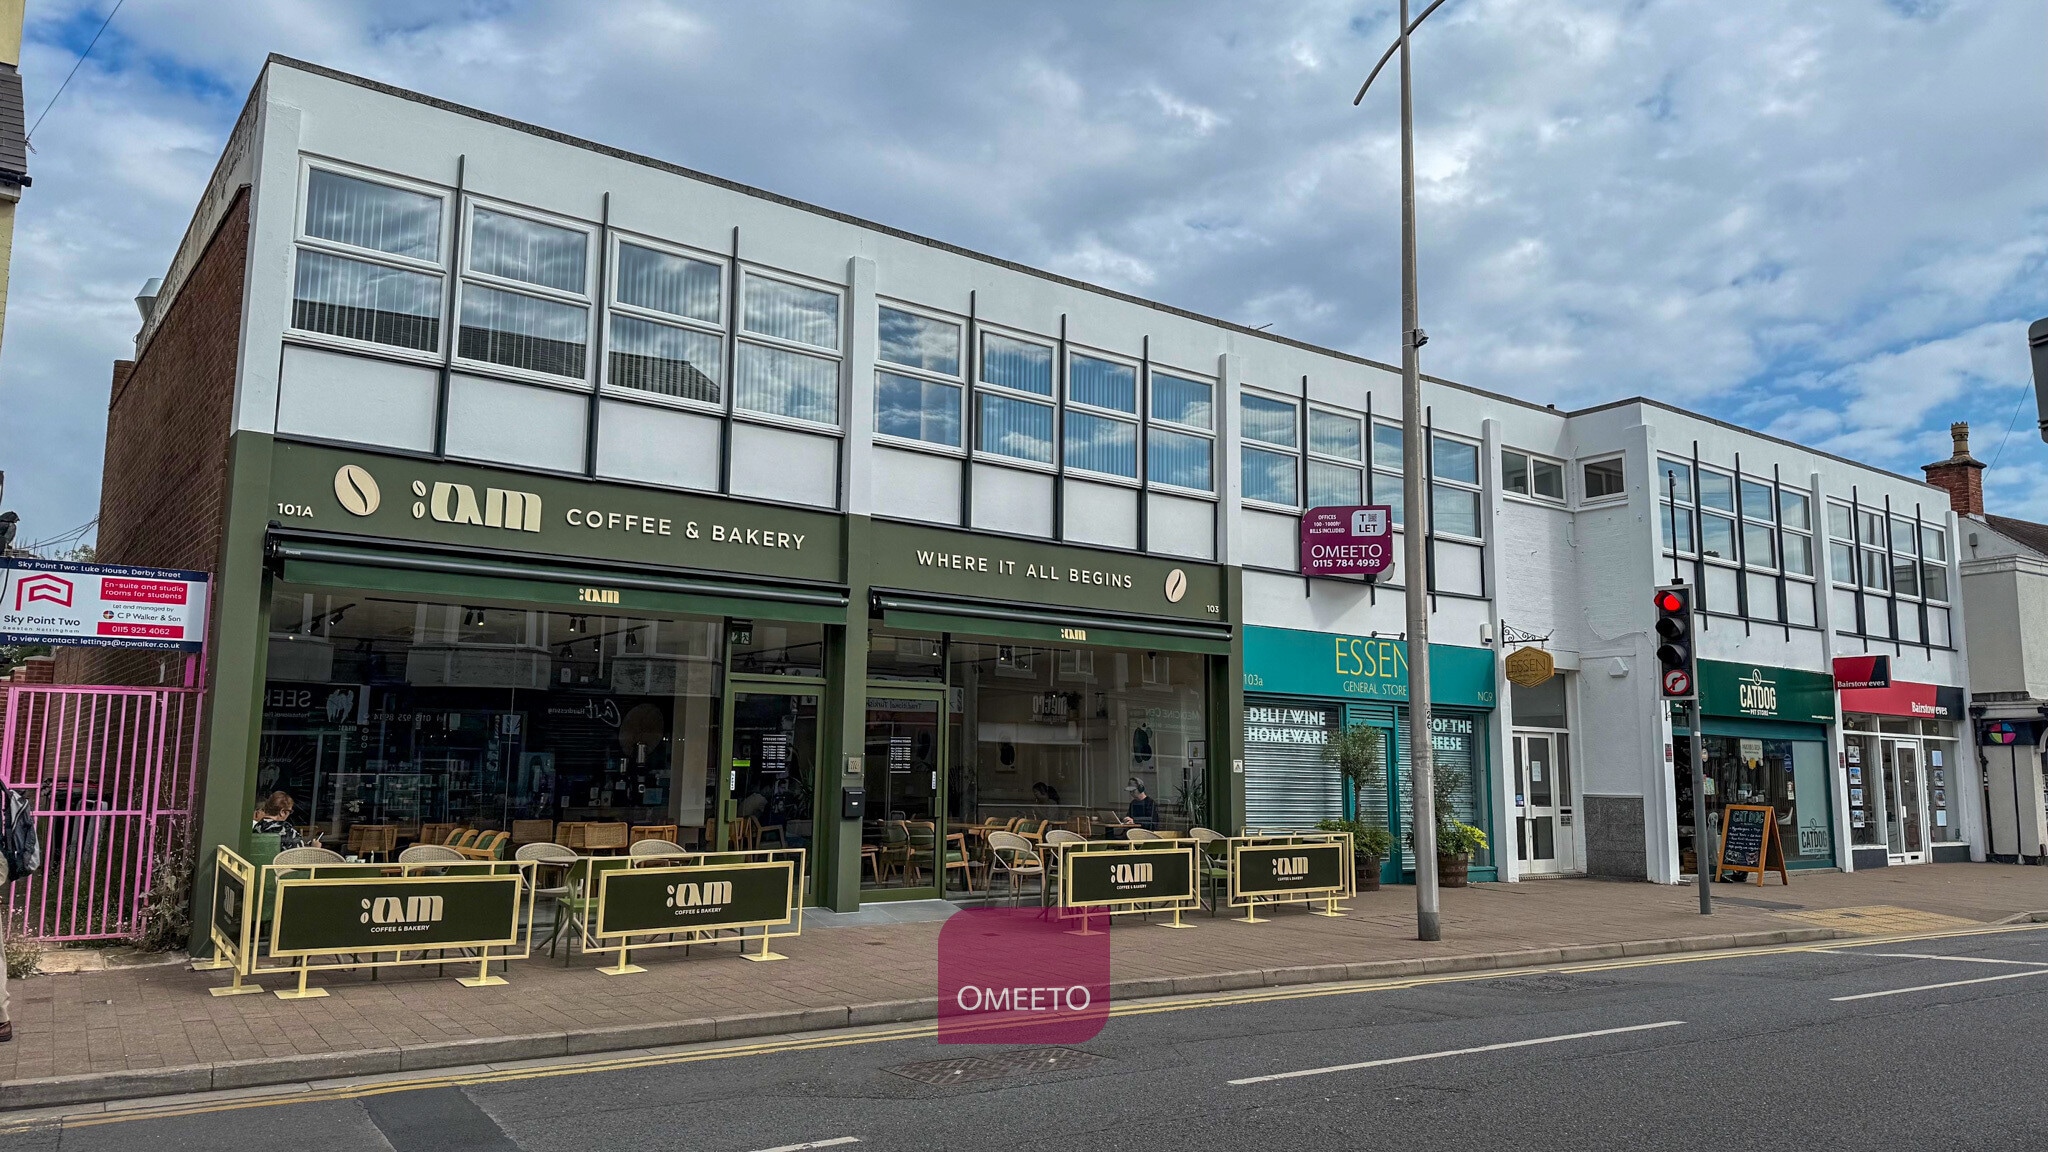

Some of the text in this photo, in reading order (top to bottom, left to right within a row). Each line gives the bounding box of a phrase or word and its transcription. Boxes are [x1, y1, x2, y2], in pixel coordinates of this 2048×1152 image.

[277, 502, 314, 518] 101A
[565, 507, 807, 551] COFFEE & BAKERY
[1359, 524, 1378, 533] LET
[1311, 543, 1383, 558] OMEETO
[17, 560, 33, 570] Sky
[35, 561, 57, 570] Point
[59, 563, 79, 571] Two:
[81, 565, 100, 573] Luke
[131, 569, 155, 578] Derby
[916, 550, 1133, 589] WHERE IT ALL BEGINS
[1336, 559, 1354, 567] 784
[1356, 559, 1380, 567] 4993
[104, 581, 139, 589] En-suite
[140, 583, 157, 591] and
[105, 589, 132, 597] rooms
[147, 592, 182, 600] students
[1206, 604, 1220, 613] 103
[4, 614, 81, 626] Sky Point Two
[132, 613, 158, 621] Walker
[111, 625, 170, 635] 0115 925 4062
[6, 634, 18, 642] To
[80, 638, 181, 649] lettings@cpwalker.co.uk
[1510, 658, 1546, 673] ESSEN
[1243, 673, 1264, 686] 103a
[1837, 680, 1868, 688] Bairstow
[1343, 680, 1407, 696] GENERAL STORE
[1477, 691, 1494, 702] NG9
[1739, 684, 1777, 710] CATDOG
[1911, 701, 1948, 716] Bairstow eves
[1433, 718, 1472, 733] OF THE
[1248, 726, 1328, 745] HOMEWARE
[1801, 830, 1828, 848] CATDOG
[403, 924, 430, 932] BAKERY
